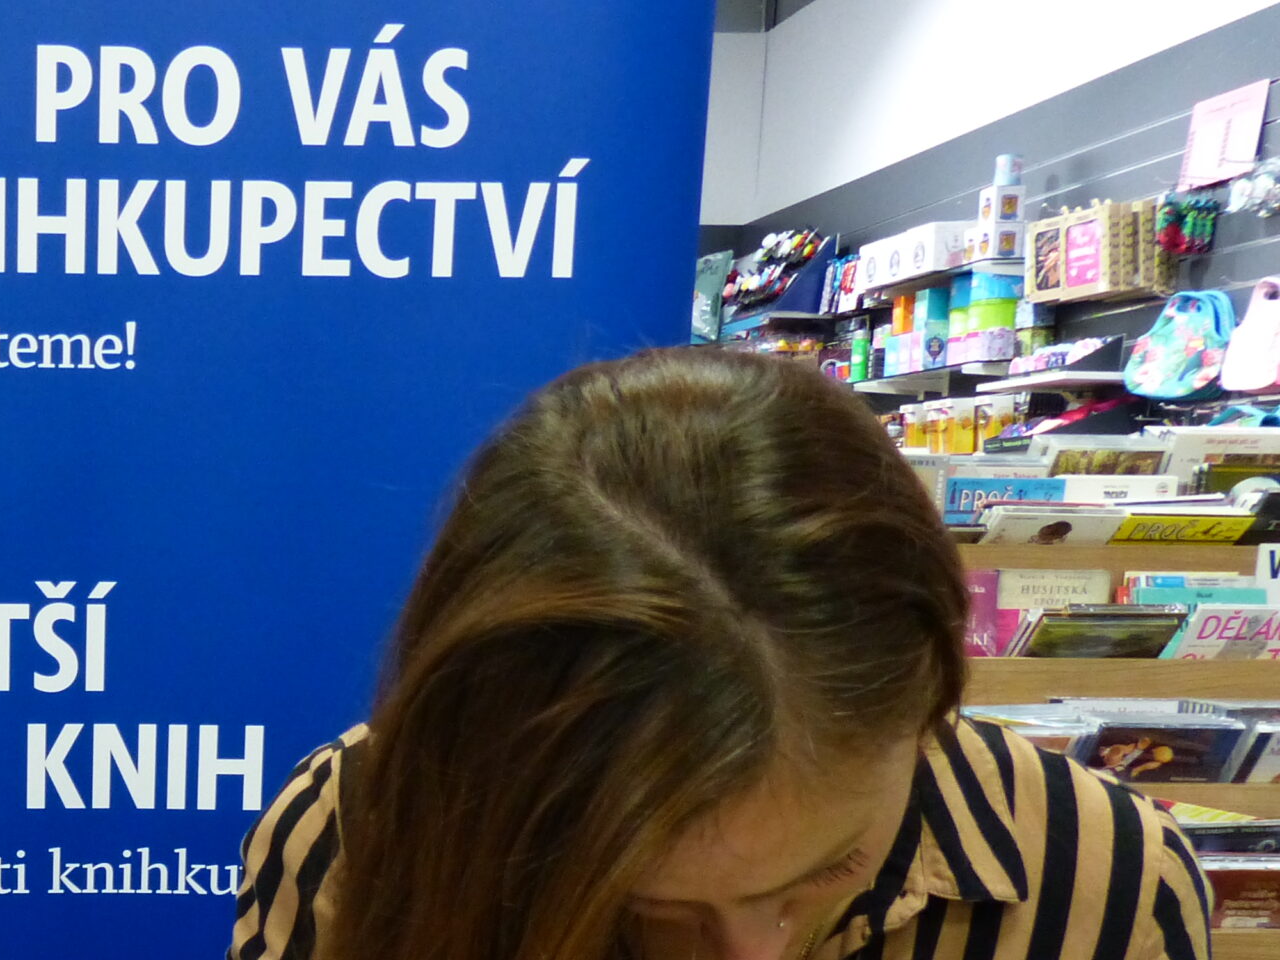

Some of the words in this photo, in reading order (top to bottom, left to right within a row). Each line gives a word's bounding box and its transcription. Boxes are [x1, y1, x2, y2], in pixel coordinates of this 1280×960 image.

[34, 44, 242, 147] PRO
[281, 23, 471, 149] VÁS
[1020, 584, 1088, 595] HUSITSKÁ
[26, 722, 266, 812] KNIH
[47, 845, 244, 897] knihku
